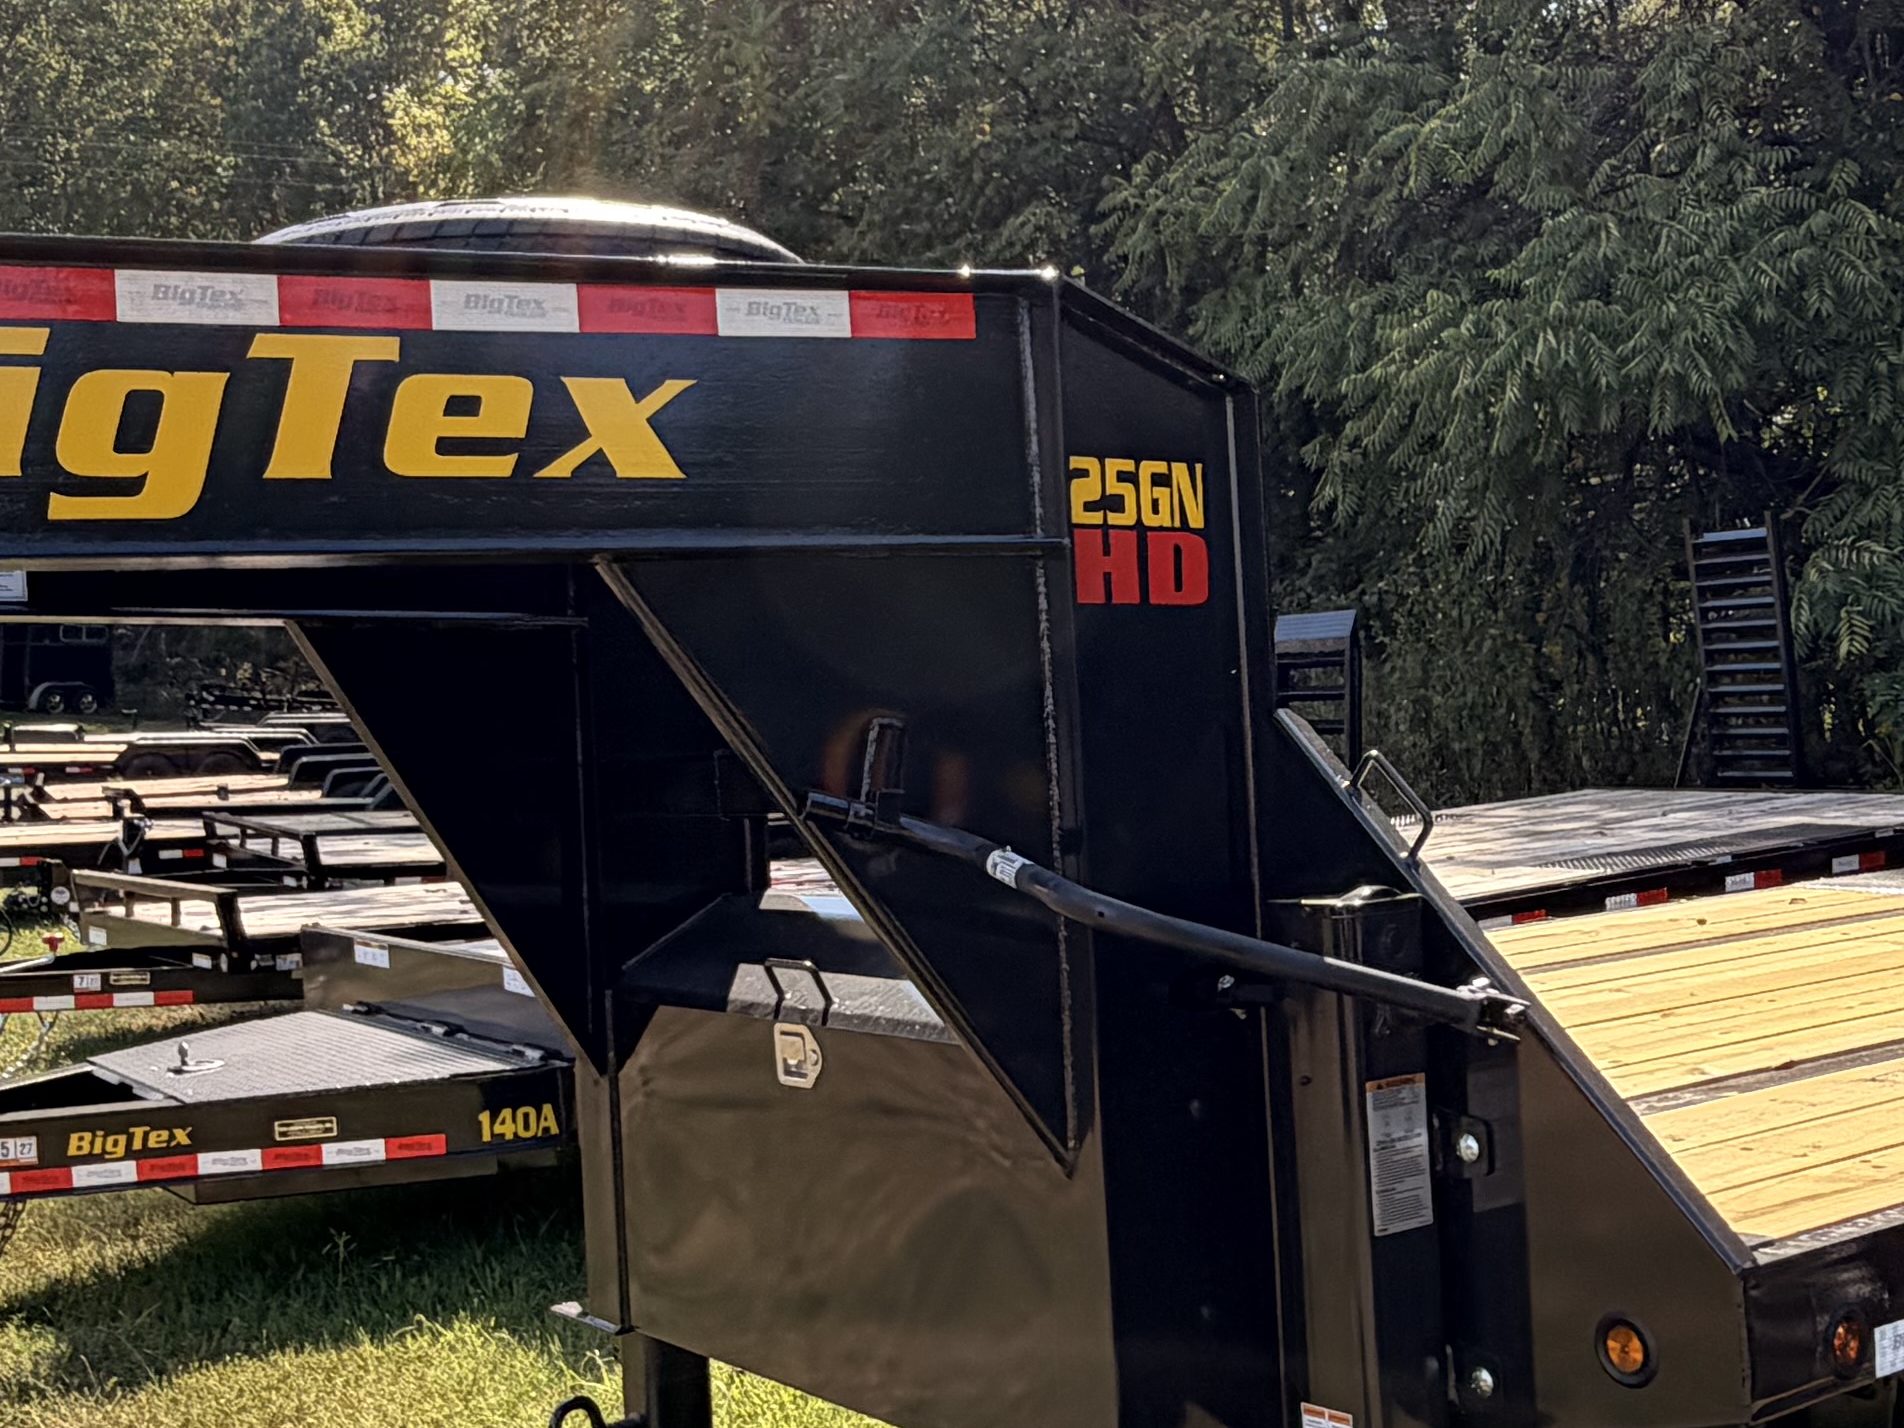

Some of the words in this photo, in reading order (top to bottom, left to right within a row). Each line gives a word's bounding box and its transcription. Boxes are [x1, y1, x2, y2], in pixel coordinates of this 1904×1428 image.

[151, 283, 245, 307] BigTex
[463, 293, 546, 315] BigTex
[744, 301, 819, 321] BigTex
[1068, 455, 1205, 529] 25GN
[1072, 528, 1210, 605] HD
[478, 1103, 560, 1142] 140A
[0, 1141, 10, 1158] 5
[18, 1142, 34, 1156] 27
[67, 1126, 193, 1159] BigTex
